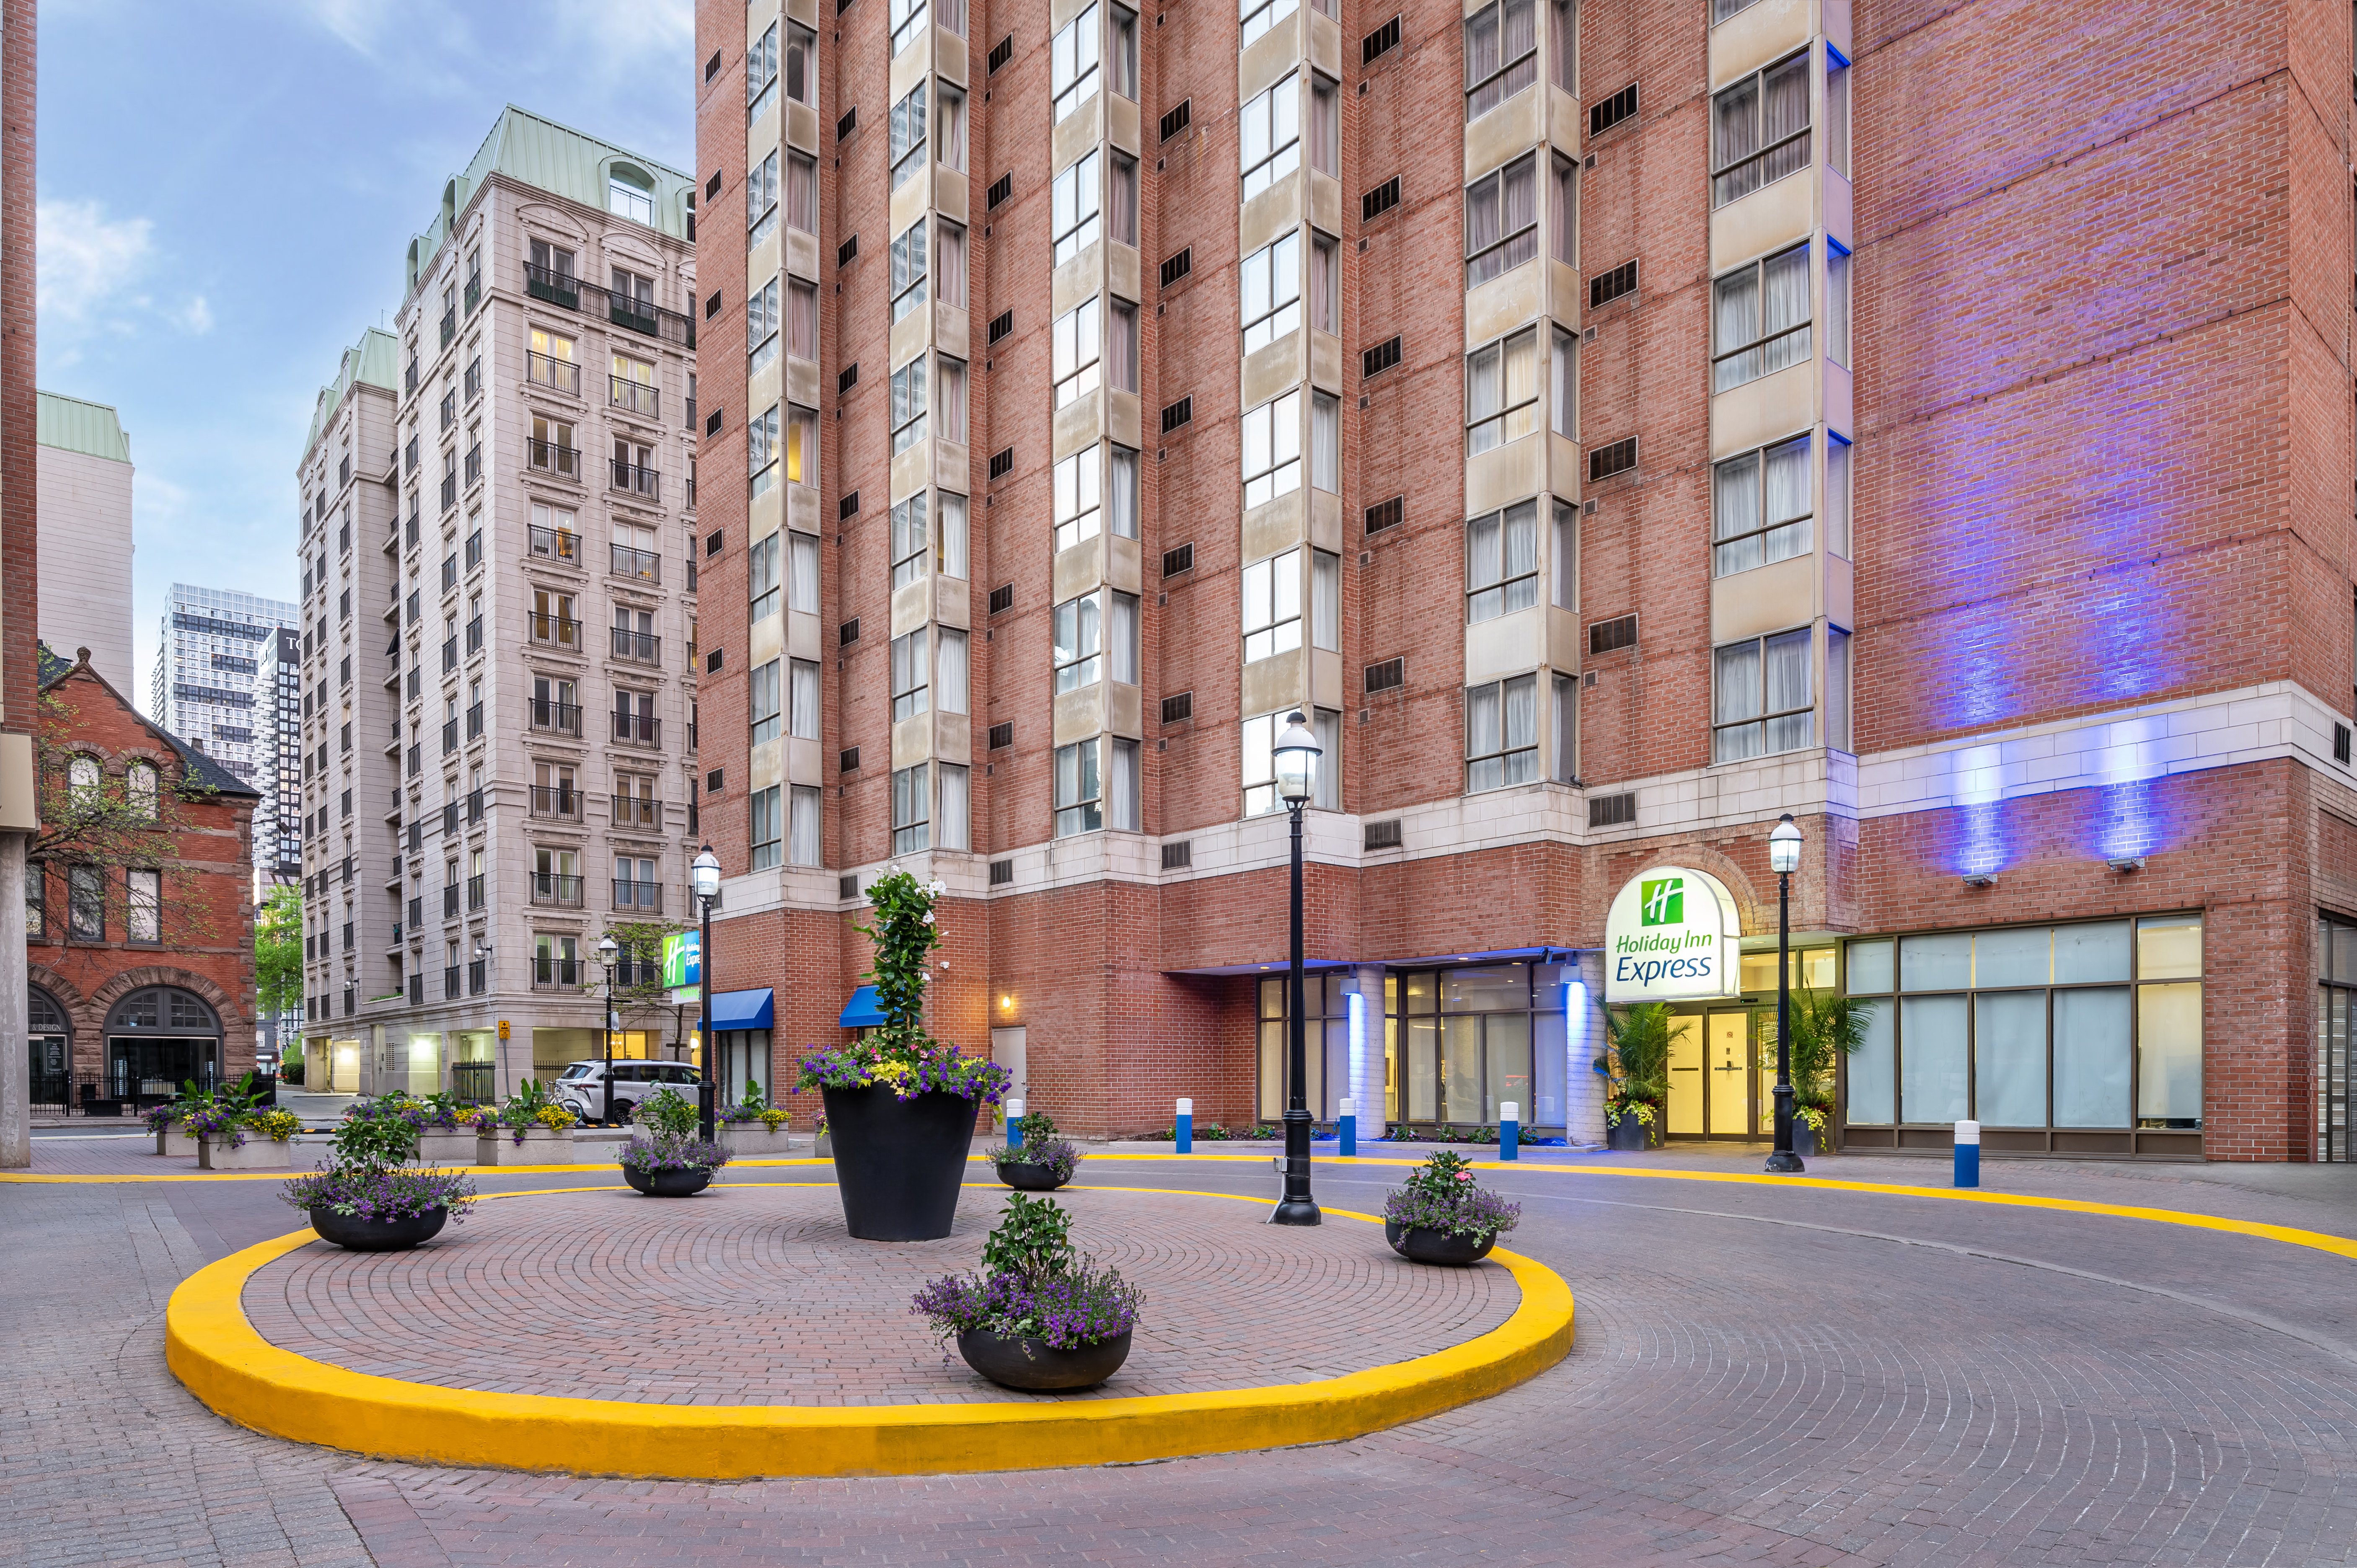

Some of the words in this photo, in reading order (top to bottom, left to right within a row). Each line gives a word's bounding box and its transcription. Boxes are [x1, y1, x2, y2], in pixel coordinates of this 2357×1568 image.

[1616, 933, 1681, 954] Holiday
[1684, 930, 1712, 948] Inn
[1616, 956, 1712, 987] Express
[680, 987, 699, 999] Parking
